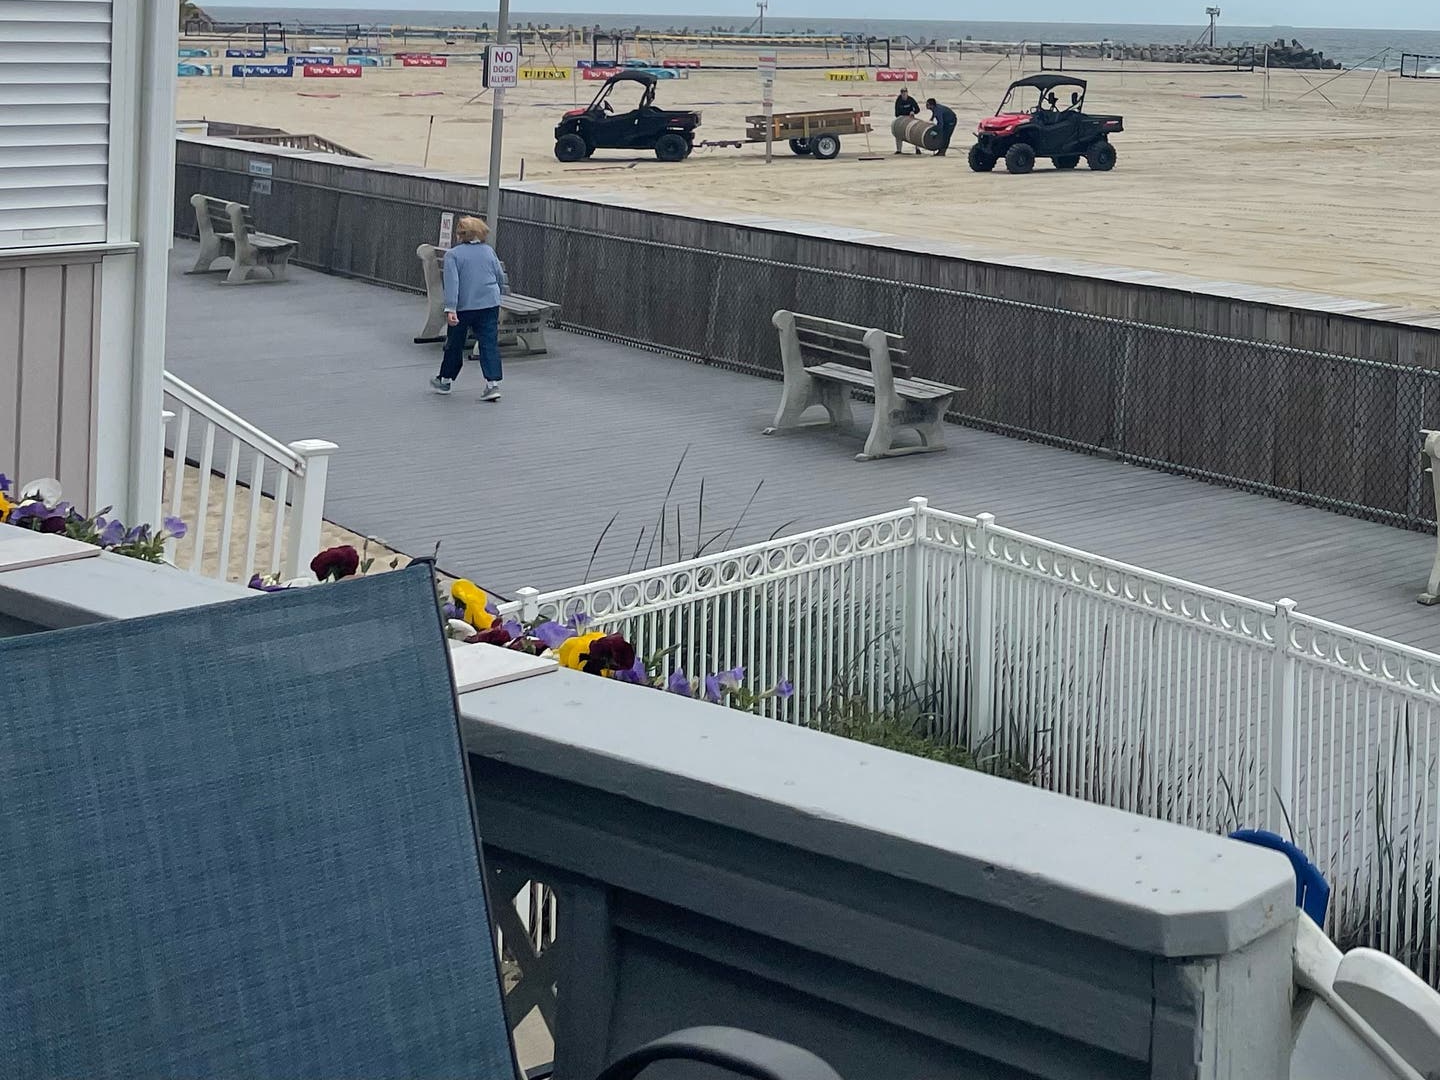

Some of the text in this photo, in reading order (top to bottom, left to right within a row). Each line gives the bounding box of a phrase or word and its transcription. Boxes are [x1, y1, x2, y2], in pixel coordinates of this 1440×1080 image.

[495, 51, 513, 63] NO
[493, 65, 514, 73] DOGS
[491, 75, 515, 83] ALLOWED
